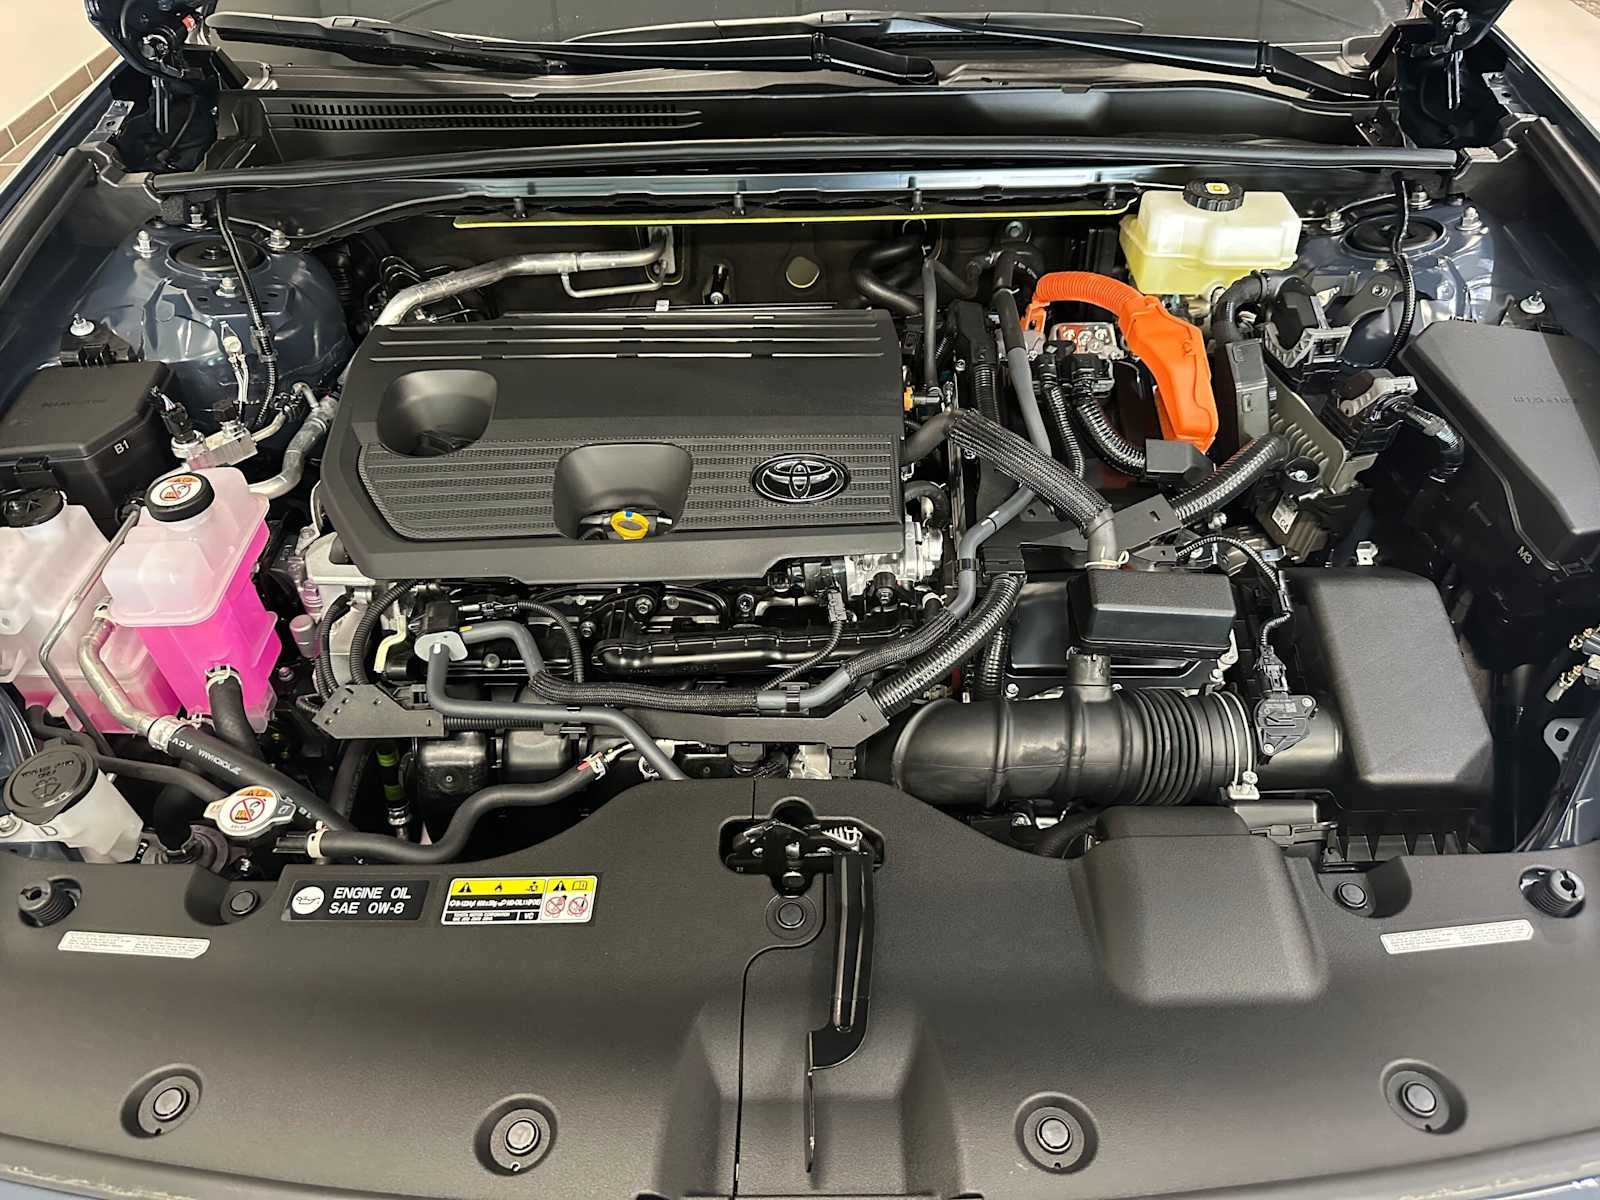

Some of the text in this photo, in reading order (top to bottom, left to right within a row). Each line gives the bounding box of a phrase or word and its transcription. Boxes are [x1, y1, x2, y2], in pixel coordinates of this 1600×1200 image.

[114, 440, 130, 455] B1
[1517, 545, 1533, 564] M3
[333, 886, 412, 899] ENGINE OIL
[328, 901, 360, 914] SAE
